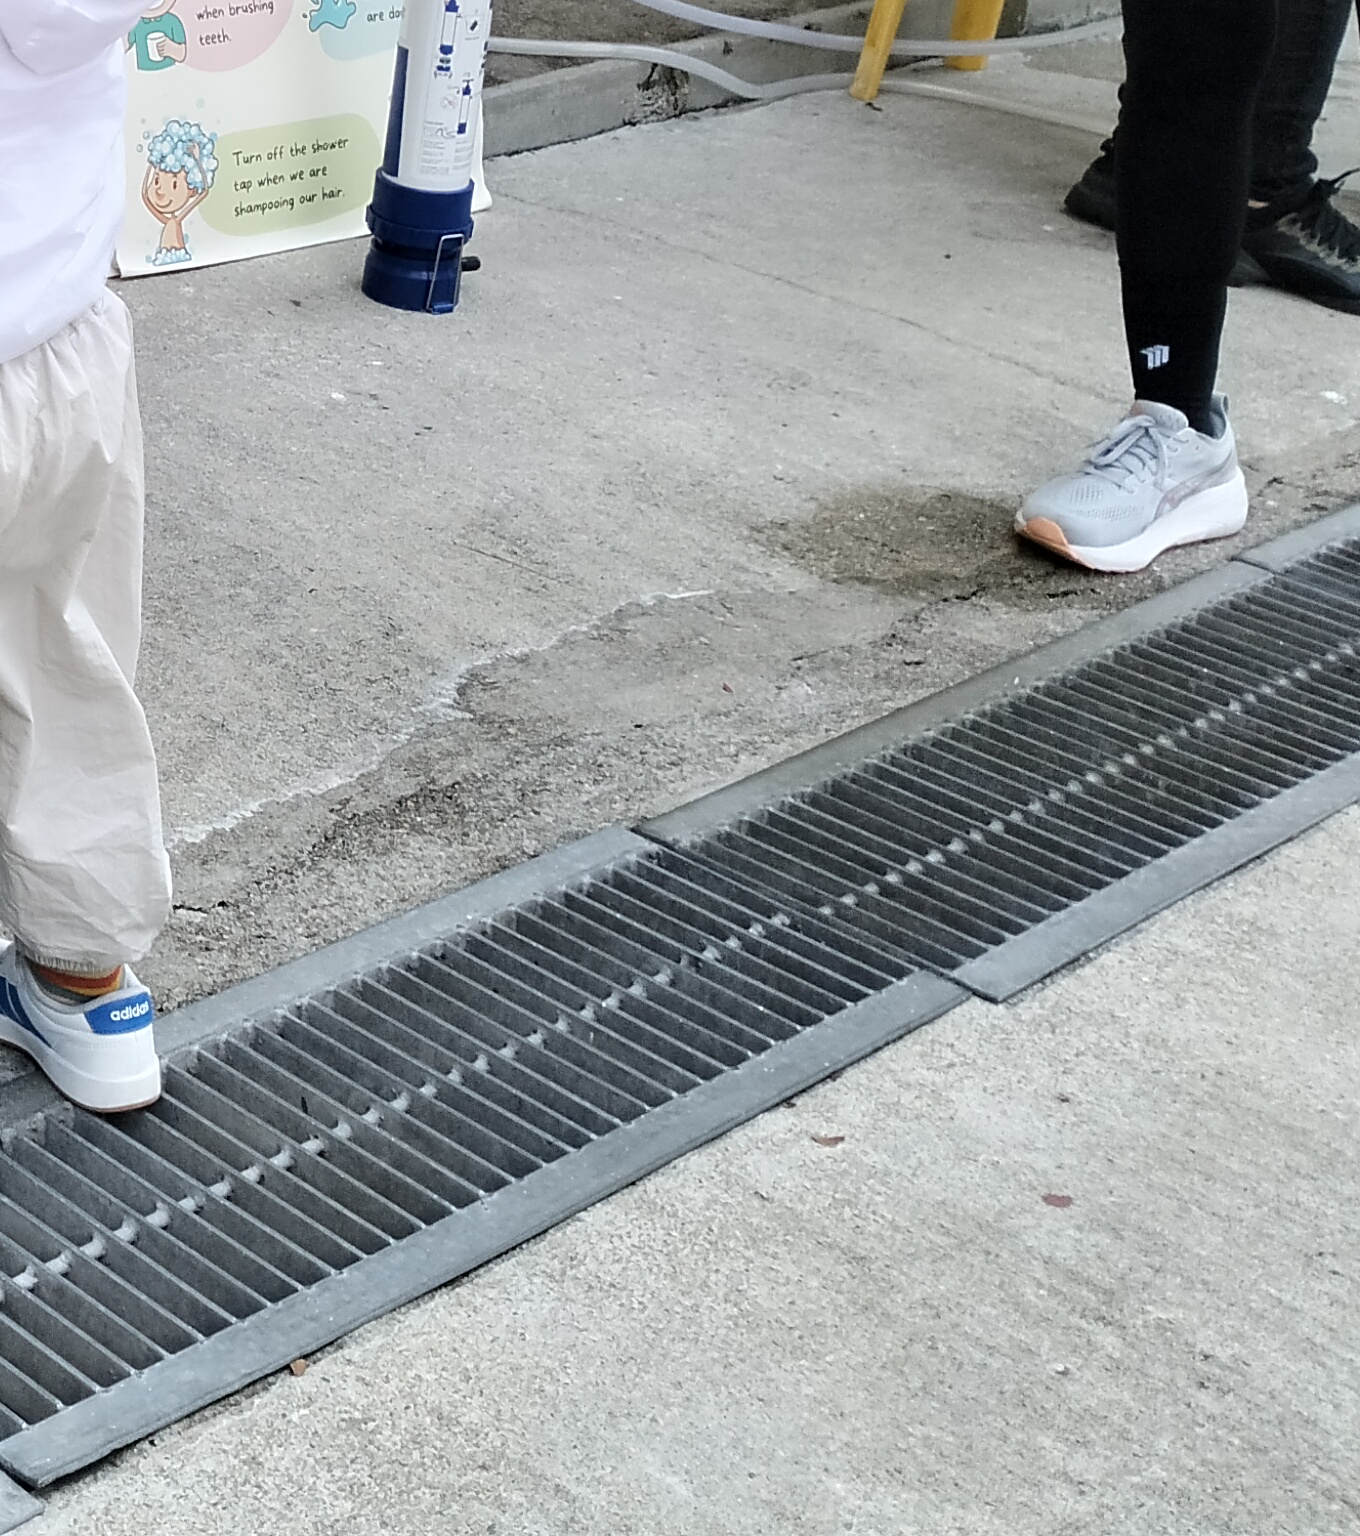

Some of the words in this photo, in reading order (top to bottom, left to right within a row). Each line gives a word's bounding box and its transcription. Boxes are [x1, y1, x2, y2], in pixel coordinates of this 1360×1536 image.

[196, 5, 225, 20] when
[367, 11, 384, 22] are
[388, 5, 406, 20] do
[199, 27, 232, 46] teeth.
[232, 151, 262, 166] Turn
[267, 146, 284, 161] off
[290, 142, 307, 157] the
[311, 138, 349, 154] shower
[234, 179, 252, 193] tap
[257, 172, 285, 187] when
[290, 170, 304, 181] we
[309, 166, 327, 177] are
[234, 197, 295, 217] shampooing
[299, 193, 317, 204] our
[321, 186, 345, 201] hair.
[110, 1000, 149, 1021] adidas
